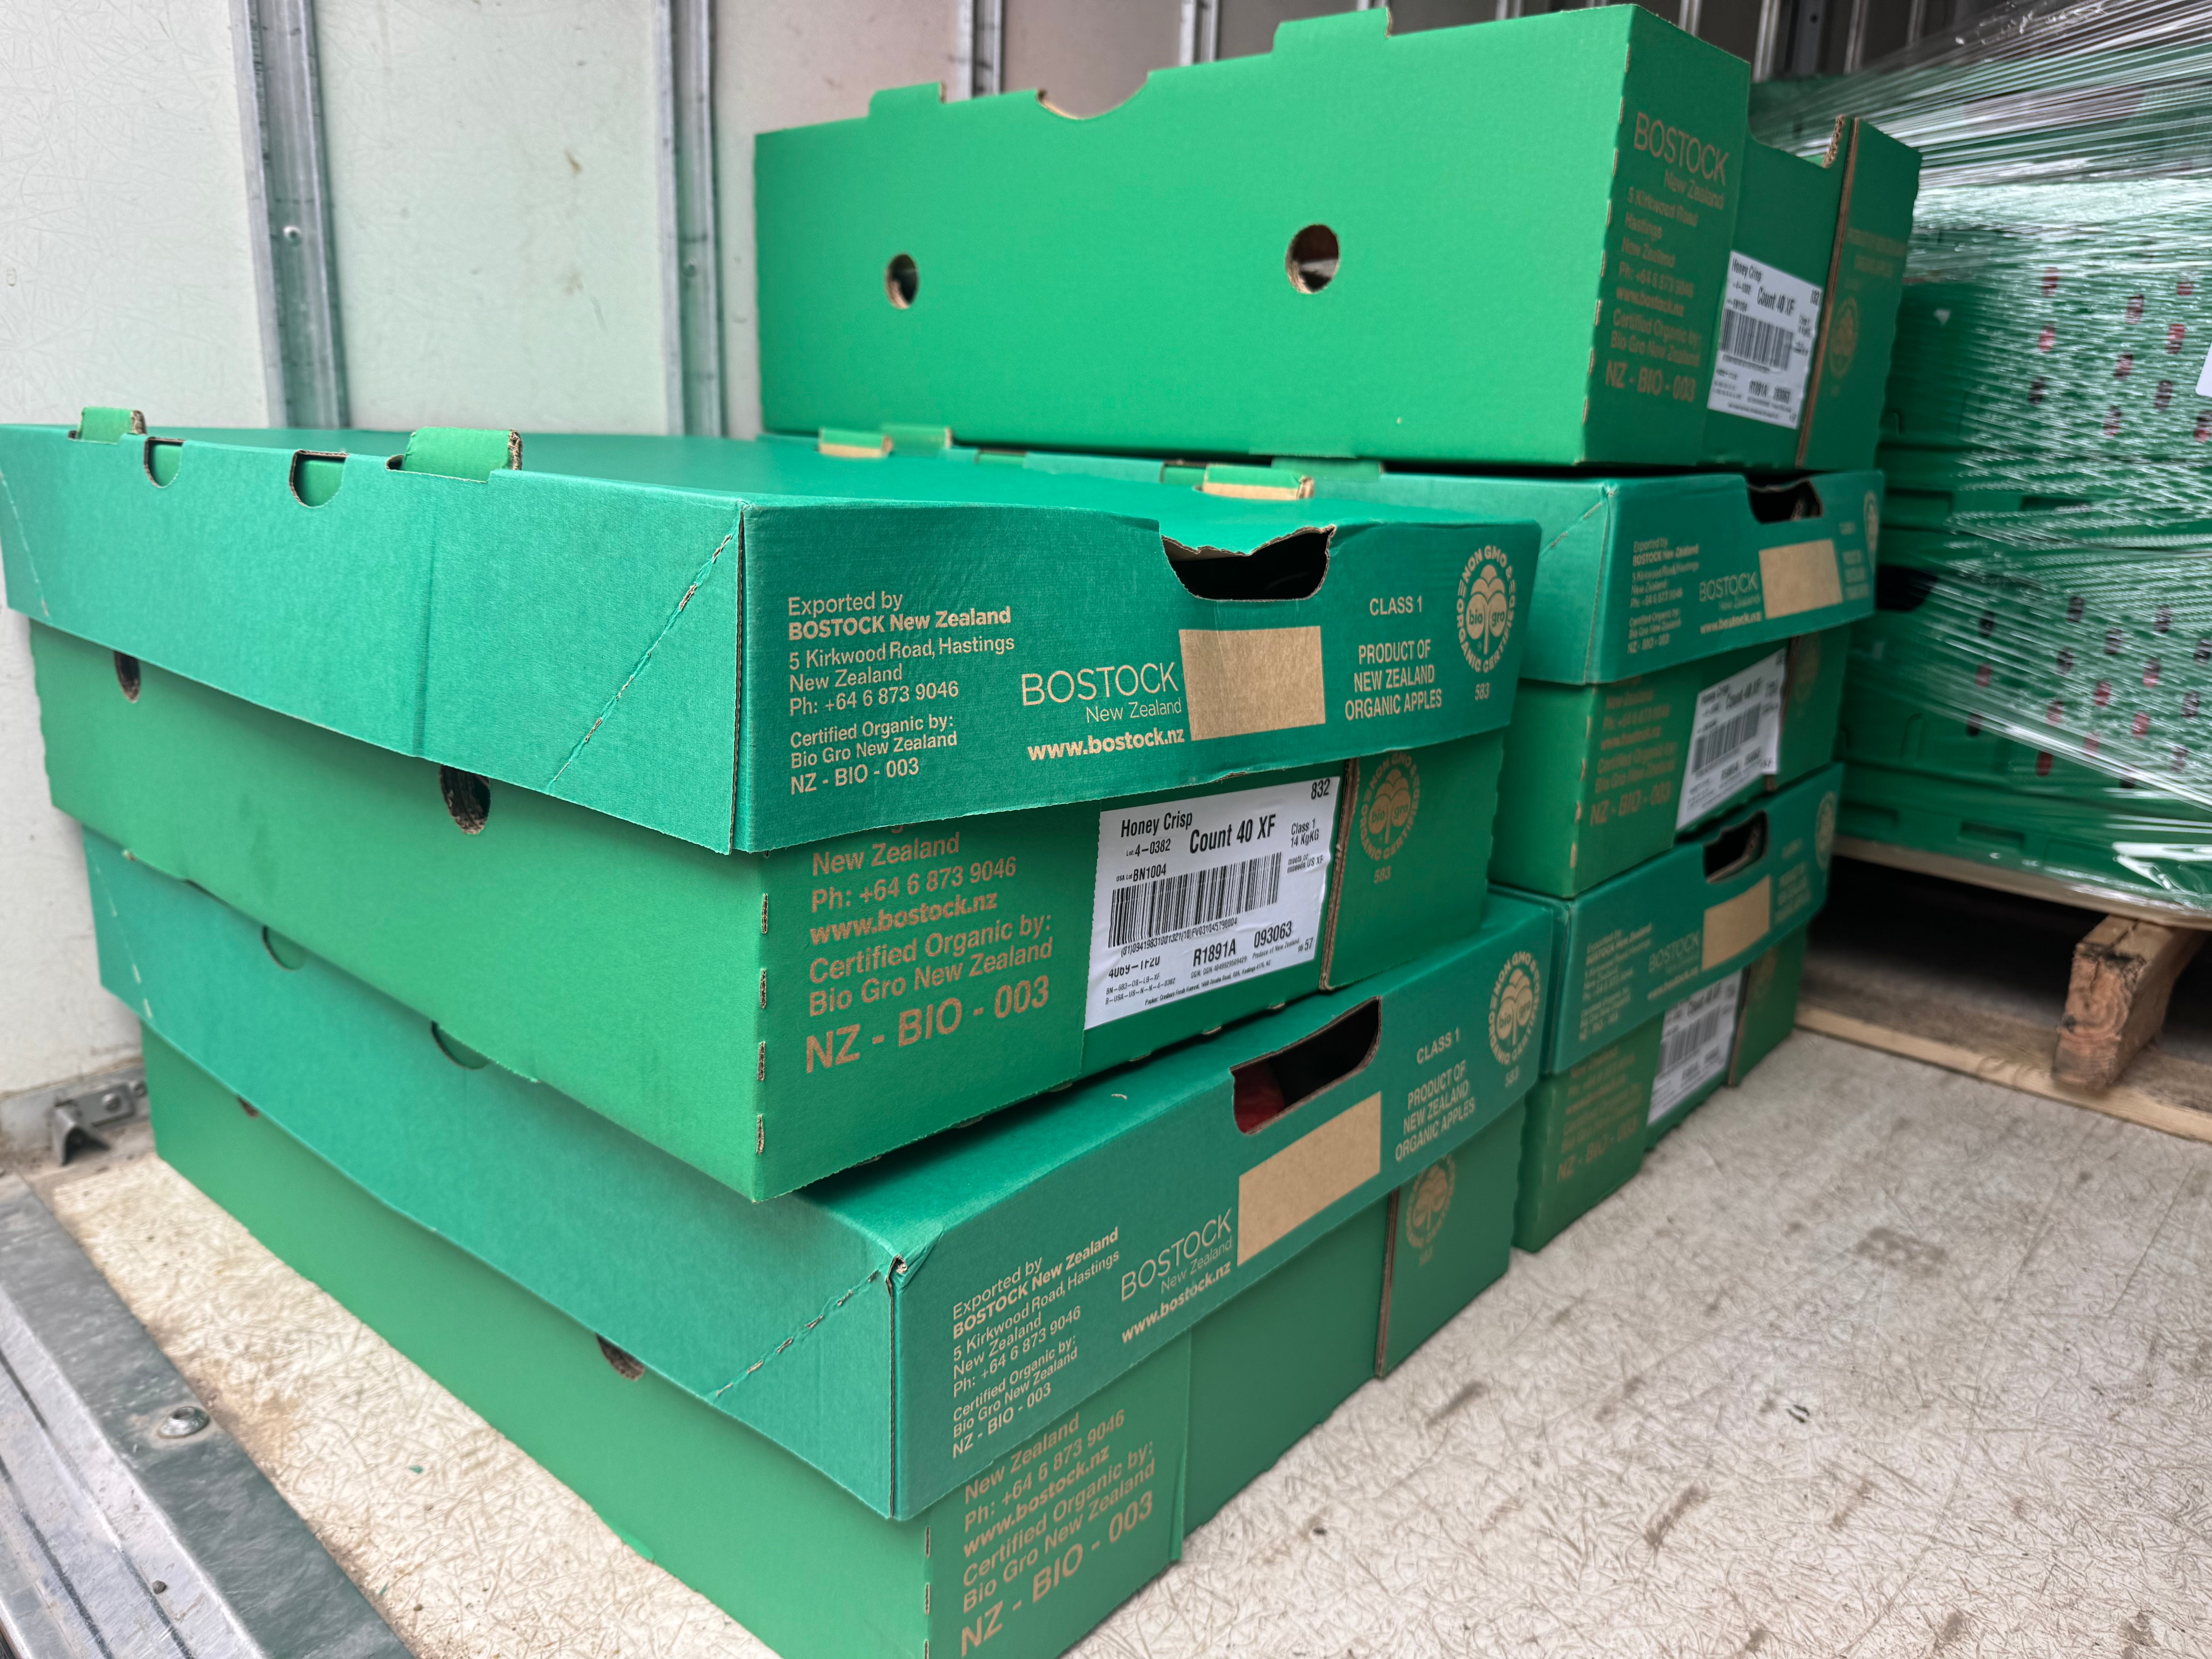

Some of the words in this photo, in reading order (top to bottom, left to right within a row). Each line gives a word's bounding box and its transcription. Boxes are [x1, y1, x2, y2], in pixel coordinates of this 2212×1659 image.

[1633, 111, 1729, 186] BOSTOCK
[1664, 170, 1686, 195] New
[1687, 180, 1724, 210] Zealand
[1731, 257, 1748, 277] Honey
[1748, 264, 1762, 283] Crisp
[1757, 286, 1776, 310] Count
[1776, 294, 1784, 313] 40
[1785, 297, 1795, 316] XF
[1462, 548, 1482, 582] NON
[1484, 545, 1507, 567] GMO
[788, 591, 875, 618] Exported
[881, 591, 903, 612] by
[1699, 572, 1758, 603] BOSTOCK
[789, 615, 885, 641] BOSTOCK
[890, 613, 931, 632] New
[935, 606, 1011, 628] Zealand
[1369, 596, 1413, 616] CLASS
[1417, 596, 1422, 612] 1
[1469, 610, 1483, 625] bio
[1492, 610, 1505, 627] gro
[790, 652, 800, 670] 5
[806, 642, 886, 668] Kirkwood
[890, 639, 935, 665] Road,
[939, 635, 1015, 655] Hastings
[1358, 641, 1415, 665] PRODUCT
[1417, 639, 1431, 659] OF
[1457, 599, 1481, 673] ORGANIC
[790, 673, 830, 693] New
[835, 663, 902, 687] Zealand
[1022, 662, 1178, 706] BOSTOCK
[1354, 670, 1382, 692] NEW
[1386, 664, 1435, 689] ZEALAND
[1475, 682, 1490, 701] 583
[790, 697, 817, 716] Ph:
[825, 691, 857, 711] +64
[863, 689, 873, 707] 6
[878, 685, 910, 705] 873
[915, 680, 959, 701] 9046
[1086, 706, 1123, 723] New
[1128, 697, 1182, 718] Zealand
[1345, 694, 1401, 721] ORGANIC
[1404, 689, 1442, 712] APPLES
[790, 723, 857, 749] Certified
[862, 719, 924, 739] Organic
[929, 716, 953, 732] by:
[791, 751, 817, 769] Bio
[823, 747, 851, 763] Gro
[856, 742, 889, 758] New
[893, 731, 957, 752] Zealand
[1027, 728, 1185, 761] www.bostock.nz
[791, 773, 817, 795] NZ
[835, 764, 868, 787] BIO
[886, 757, 919, 778] 003
[1311, 778, 1331, 800] 832
[1121, 818, 1159, 837] Honey
[1164, 810, 1192, 830] Crisp
[1291, 822, 1309, 835] Class
[1312, 817, 1315, 829] 1
[1372, 809, 1386, 823] bio
[1394, 803, 1408, 818] gro
[1190, 824, 1232, 854] Count
[1237, 819, 1253, 843] 40
[1257, 814, 1276, 839] XF
[1291, 835, 1298, 848] 14
[1301, 828, 1319, 846] KgKG
[813, 852, 864, 876] New
[871, 832, 960, 867] Zealand
[1287, 861, 1305, 873] exceeds
[1307, 857, 1314, 867] US
[1316, 855, 1323, 865] XF
[1288, 855, 1302, 866] meets
[812, 886, 852, 913] Ph:
[859, 877, 900, 903] +64
[907, 873, 920, 895] 6
[926, 866, 963, 892] 873
[970, 856, 1016, 883] 9046
[1133, 863, 1166, 882] BN1004
[1374, 866, 1391, 884] 583
[810, 893, 998, 945] www.bostock.nz
[1254, 921, 1292, 948] 093063
[810, 938, 917, 984] Certified
[925, 923, 1013, 957] Organic
[1019, 915, 1051, 939] by:
[1193, 938, 1236, 967] R1891A
[1252, 950, 1267, 960] Produce
[1284, 938, 1299, 948] Zealand
[1305, 937, 1313, 951] 57
[810, 988, 852, 1017] Bio
[861, 977, 906, 1003] Gro
[914, 962, 963, 991] New
[969, 936, 1053, 977] Zealand
[806, 1024, 860, 1073] NZ
[898, 998, 962, 1047] BIO
[994, 975, 1049, 1018] 003
[1417, 1032, 1452, 1064] CLASS
[1455, 1028, 1460, 1041] 1
[1408, 1068, 1452, 1110] PRODUCT
[1454, 1060, 1466, 1082] OF
[1404, 1108, 1425, 1134] NEW
[1427, 1080, 1468, 1120] ZEALAND
[1395, 1120, 1439, 1162] ORGANIC
[1441, 1097, 1475, 1131] APPLES
[1121, 1209, 1231, 1302] BOSTOCK
[1161, 1271, 1186, 1294] New
[1190, 1237, 1233, 1275] Zealand
[953, 1281, 1028, 1339] BOSTOCK
[1032, 1264, 1062, 1291] New
[1066, 1226, 1118, 1271] Zealand
[953, 1266, 1022, 1320] Exported
[1023, 1257, 1042, 1286] by
[954, 1345, 962, 1362] 5
[967, 1302, 1029, 1353] Kirkwood
[1032, 1281, 1065, 1313] Road,
[1068, 1251, 1120, 1290] Hastings
[1122, 1262, 1231, 1343] www.bostock.nz
[953, 1378, 1006, 1421] Certified
[1010, 1349, 1055, 1385] Organic
[1059, 1336, 1078, 1354] by:
[953, 1433, 973, 1458] NZ
[988, 1407, 1014, 1435] BIO
[1027, 1382, 1051, 1408] 003
[965, 1466, 1005, 1504] New
[1010, 1412, 1079, 1474] Zealand
[963, 1446, 1109, 1557] www.bostock.nz
[962, 1601, 1003, 1657] NZ
[1032, 1544, 1083, 1603] BIO
[1109, 1491, 1152, 1543] 003
